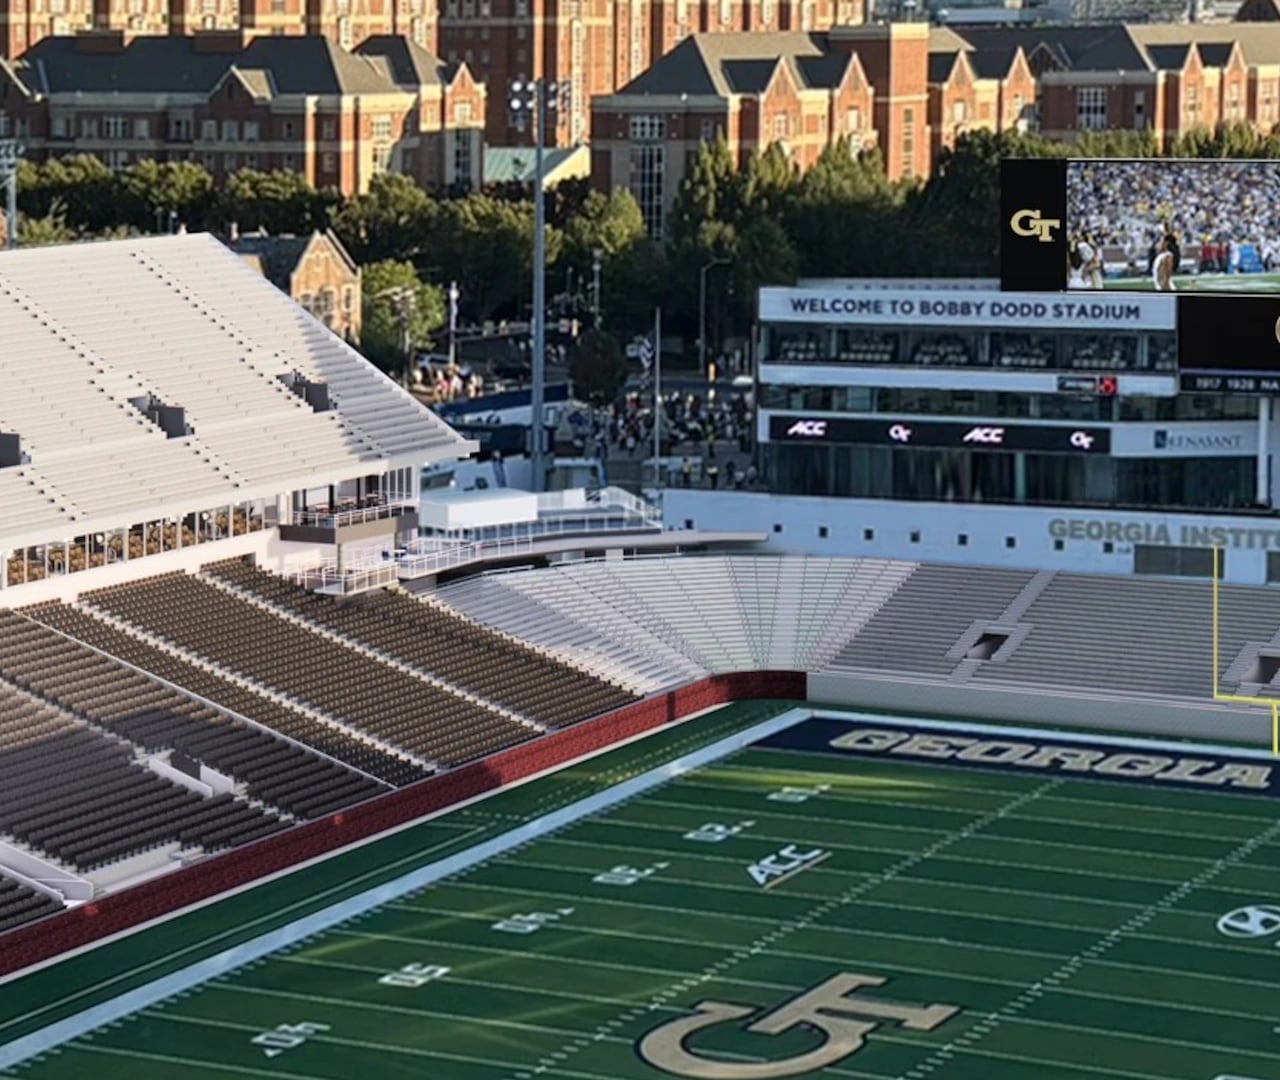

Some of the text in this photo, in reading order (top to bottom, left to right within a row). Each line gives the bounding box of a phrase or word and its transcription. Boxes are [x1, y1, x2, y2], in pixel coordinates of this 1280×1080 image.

[1010, 209, 1060, 243] GT
[791, 298, 1141, 321] WELCOME TO BOBBY DODD STADIUM
[787, 420, 827, 437] ACC
[962, 427, 1005, 444] ACC
[1048, 518, 1171, 546] GEORGIA
[828, 727, 1271, 790] GEORGIA
[747, 844, 824, 886] ACC
[636, 971, 962, 1080] GT
